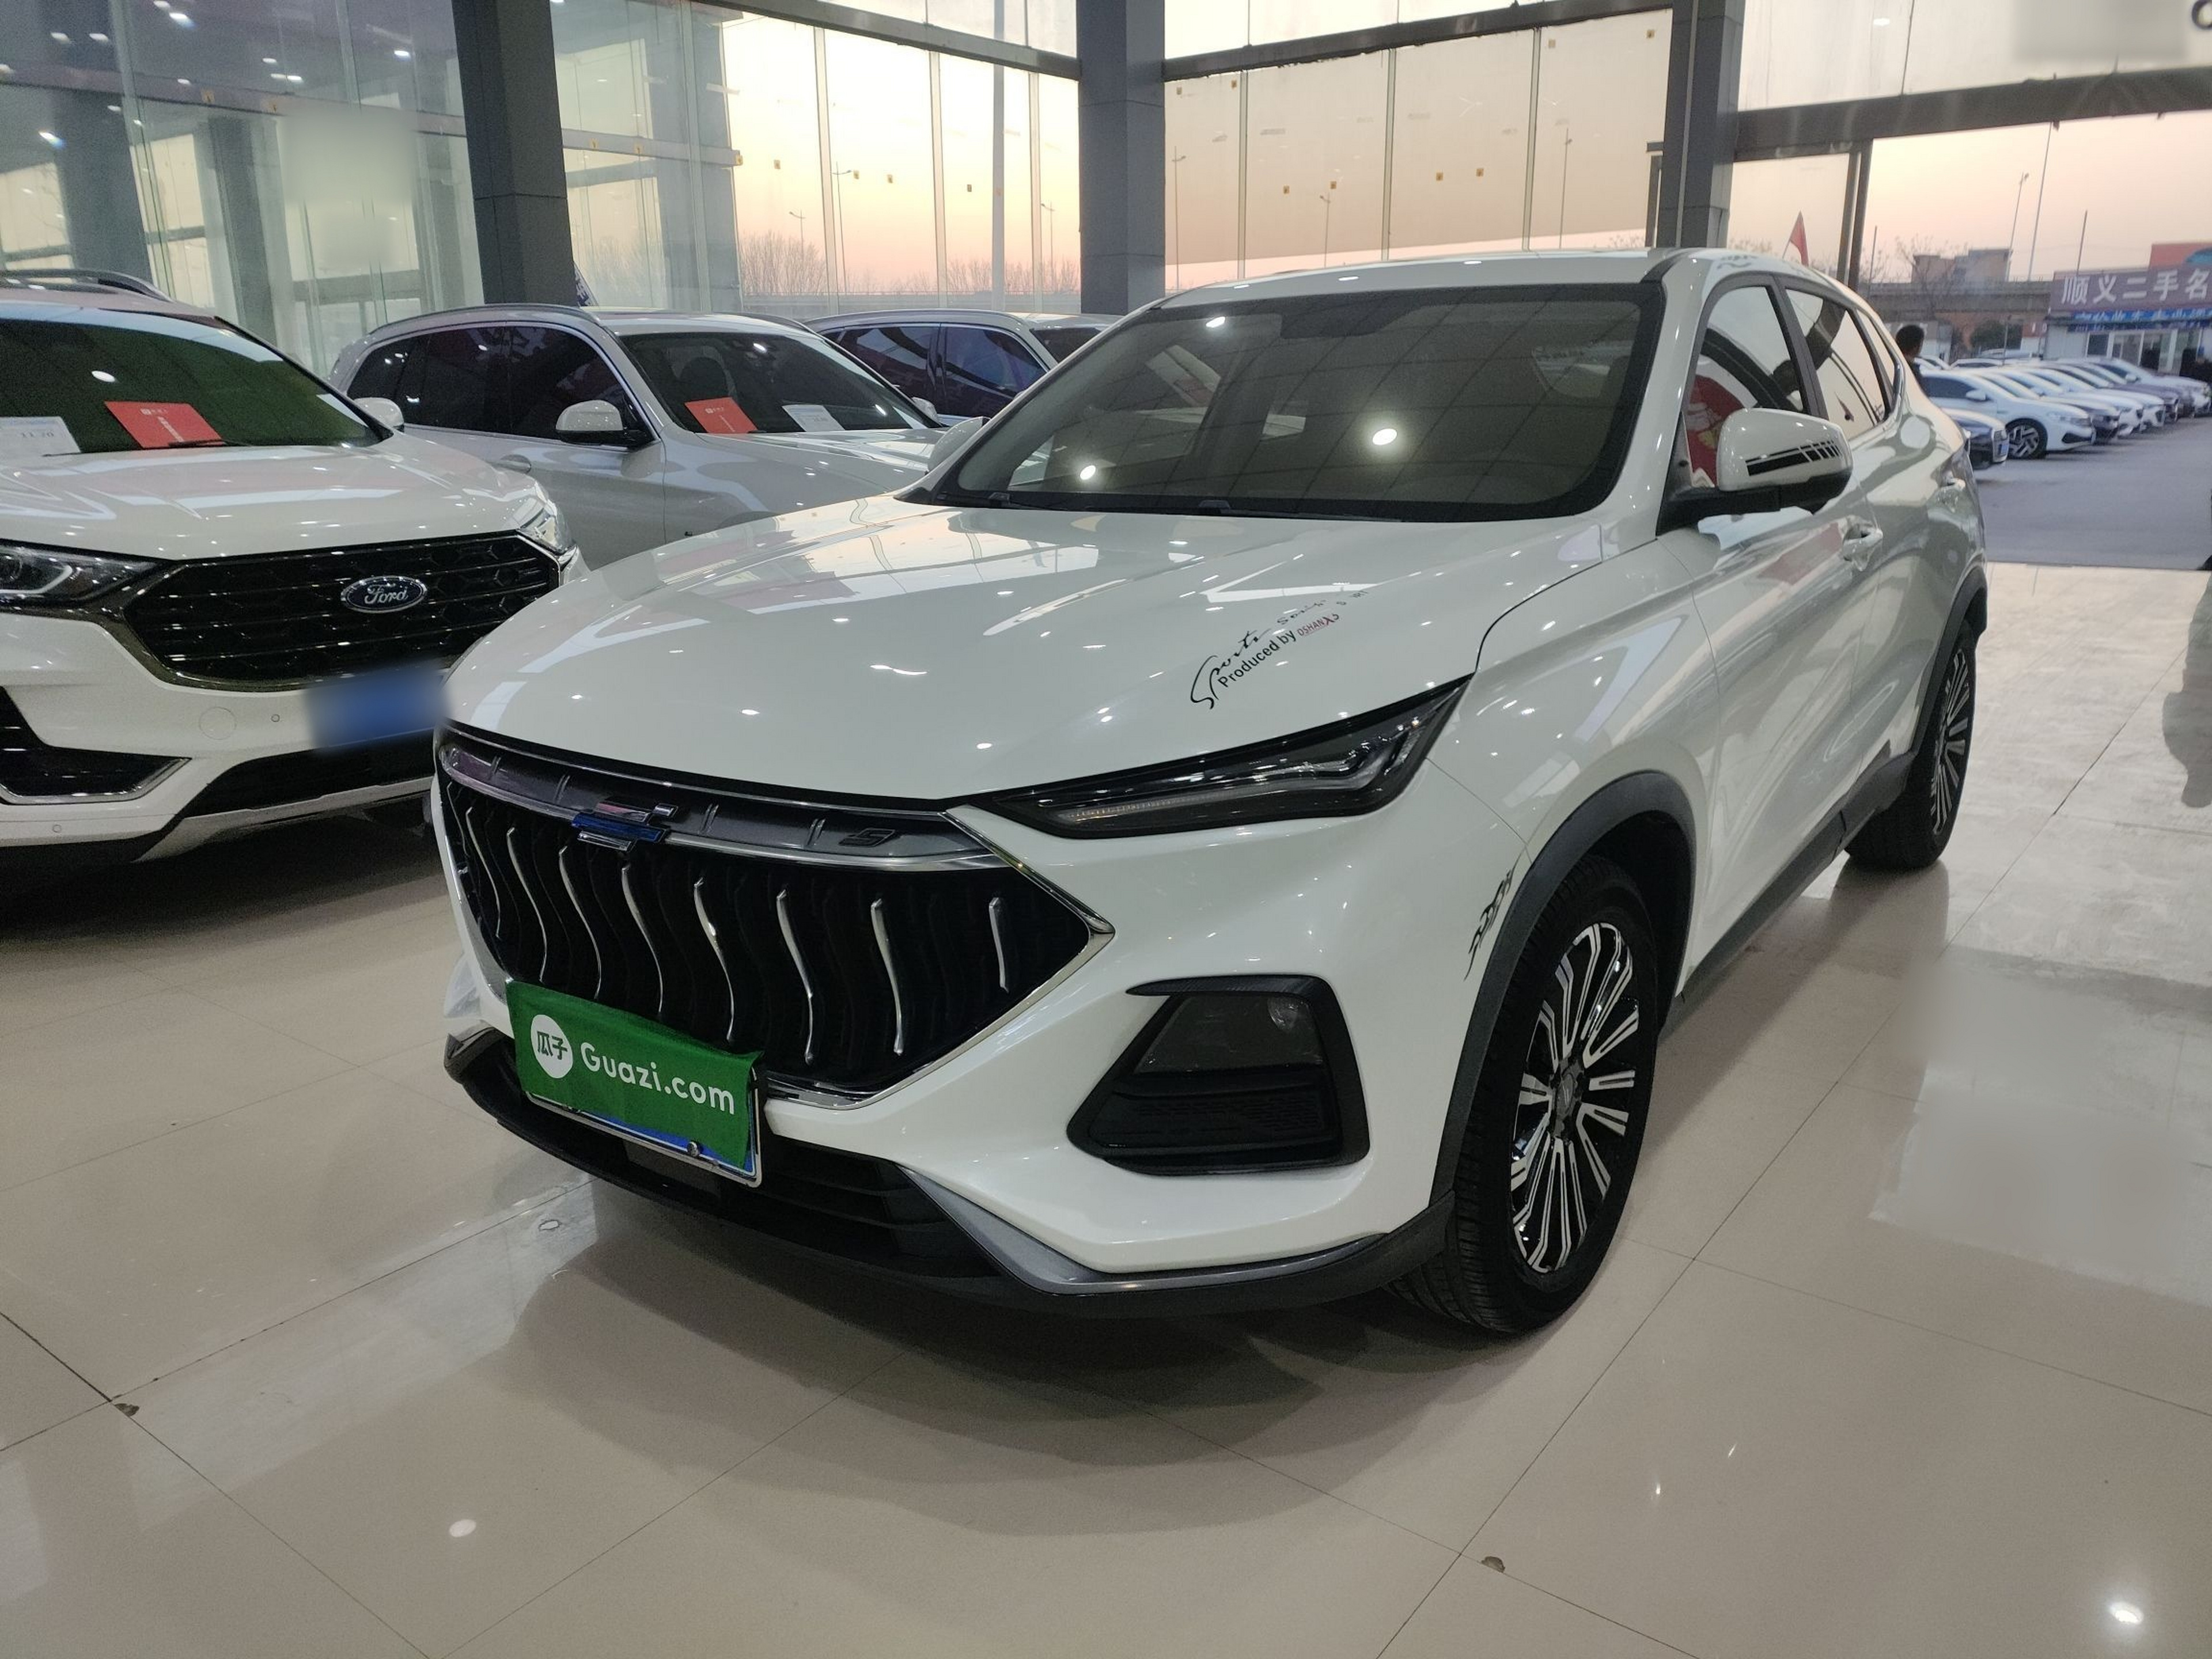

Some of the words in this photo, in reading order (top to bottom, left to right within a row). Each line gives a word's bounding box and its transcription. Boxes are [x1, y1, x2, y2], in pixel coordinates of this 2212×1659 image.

[2061, 268, 2210, 305] 顺义二手名
[365, 584, 408, 604] Ford
[1218, 640, 1280, 687] Produced
[1277, 630, 1296, 644] by
[537, 1031, 567, 1060] 瓜子
[581, 1042, 734, 1114] Guazi.com
